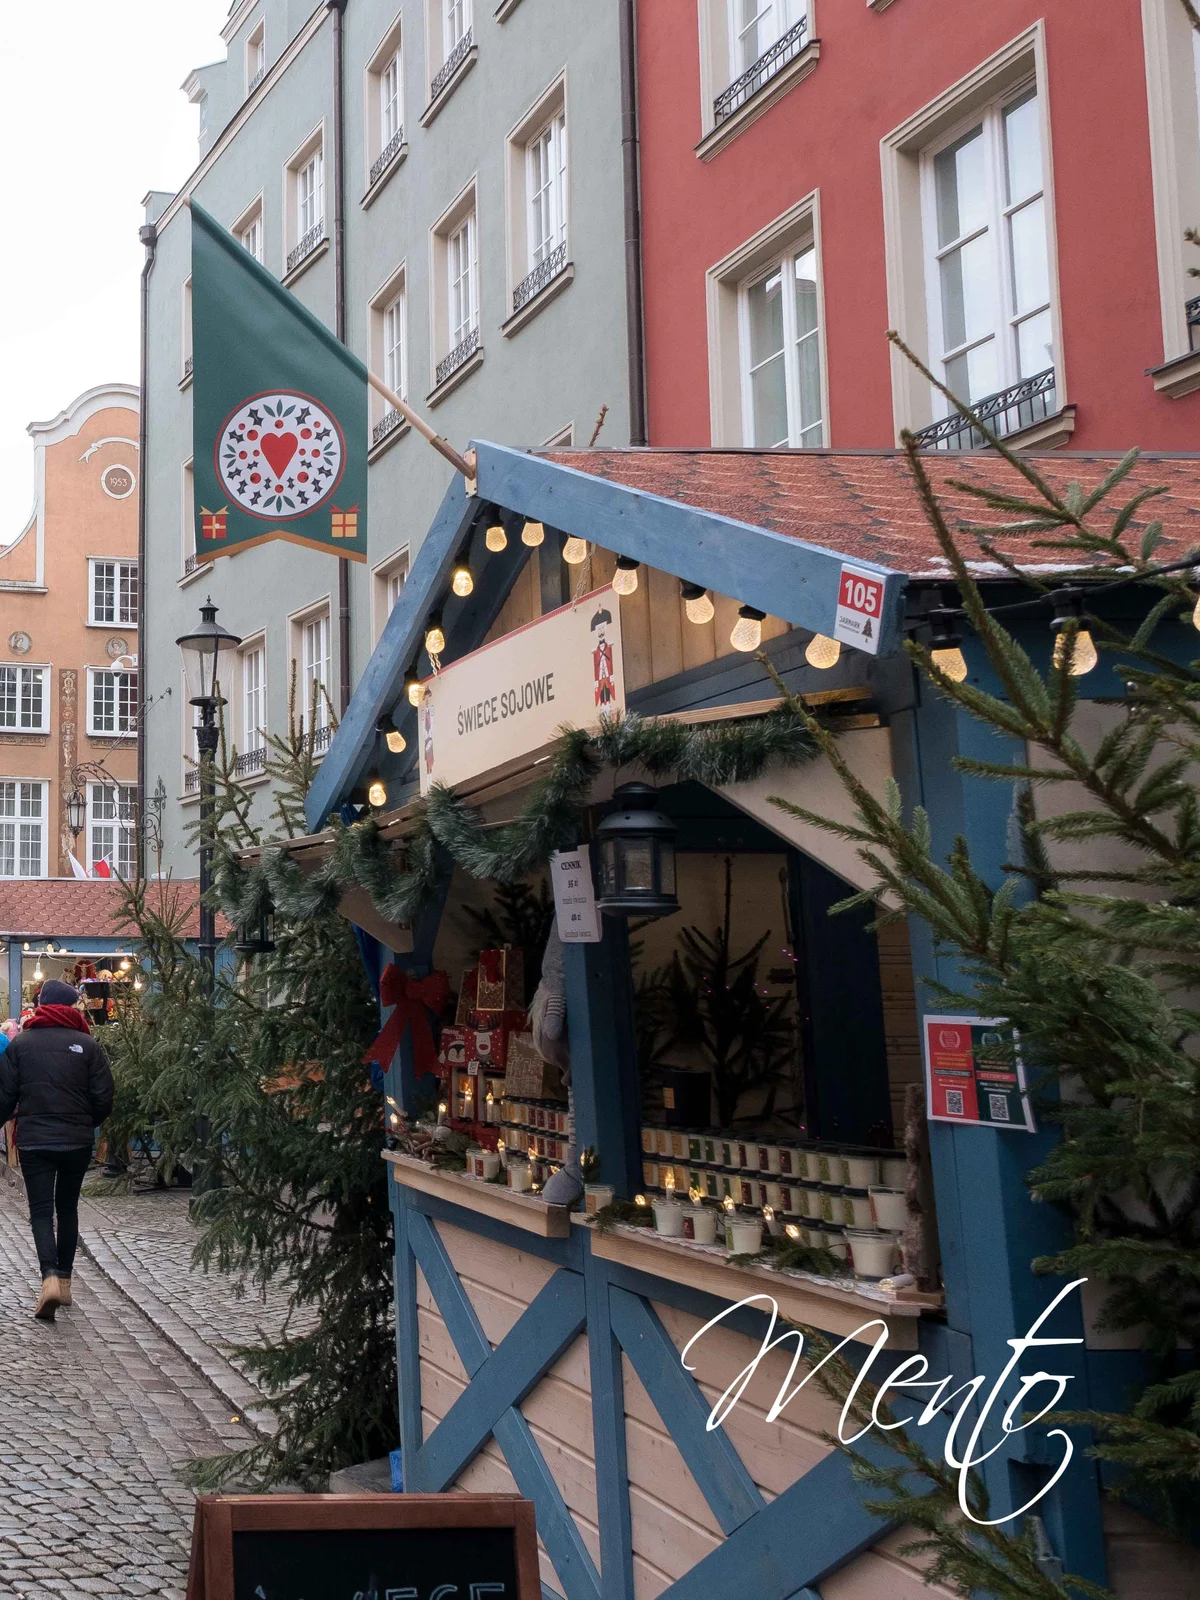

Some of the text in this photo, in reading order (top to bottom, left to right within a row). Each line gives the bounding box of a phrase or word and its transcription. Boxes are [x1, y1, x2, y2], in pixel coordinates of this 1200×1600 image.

[110, 478, 128, 487] 1953
[845, 579, 877, 612] 105
[457, 672, 554, 736] ŚWIECE SOJOWE
[561, 860, 582, 870] CENNIK
